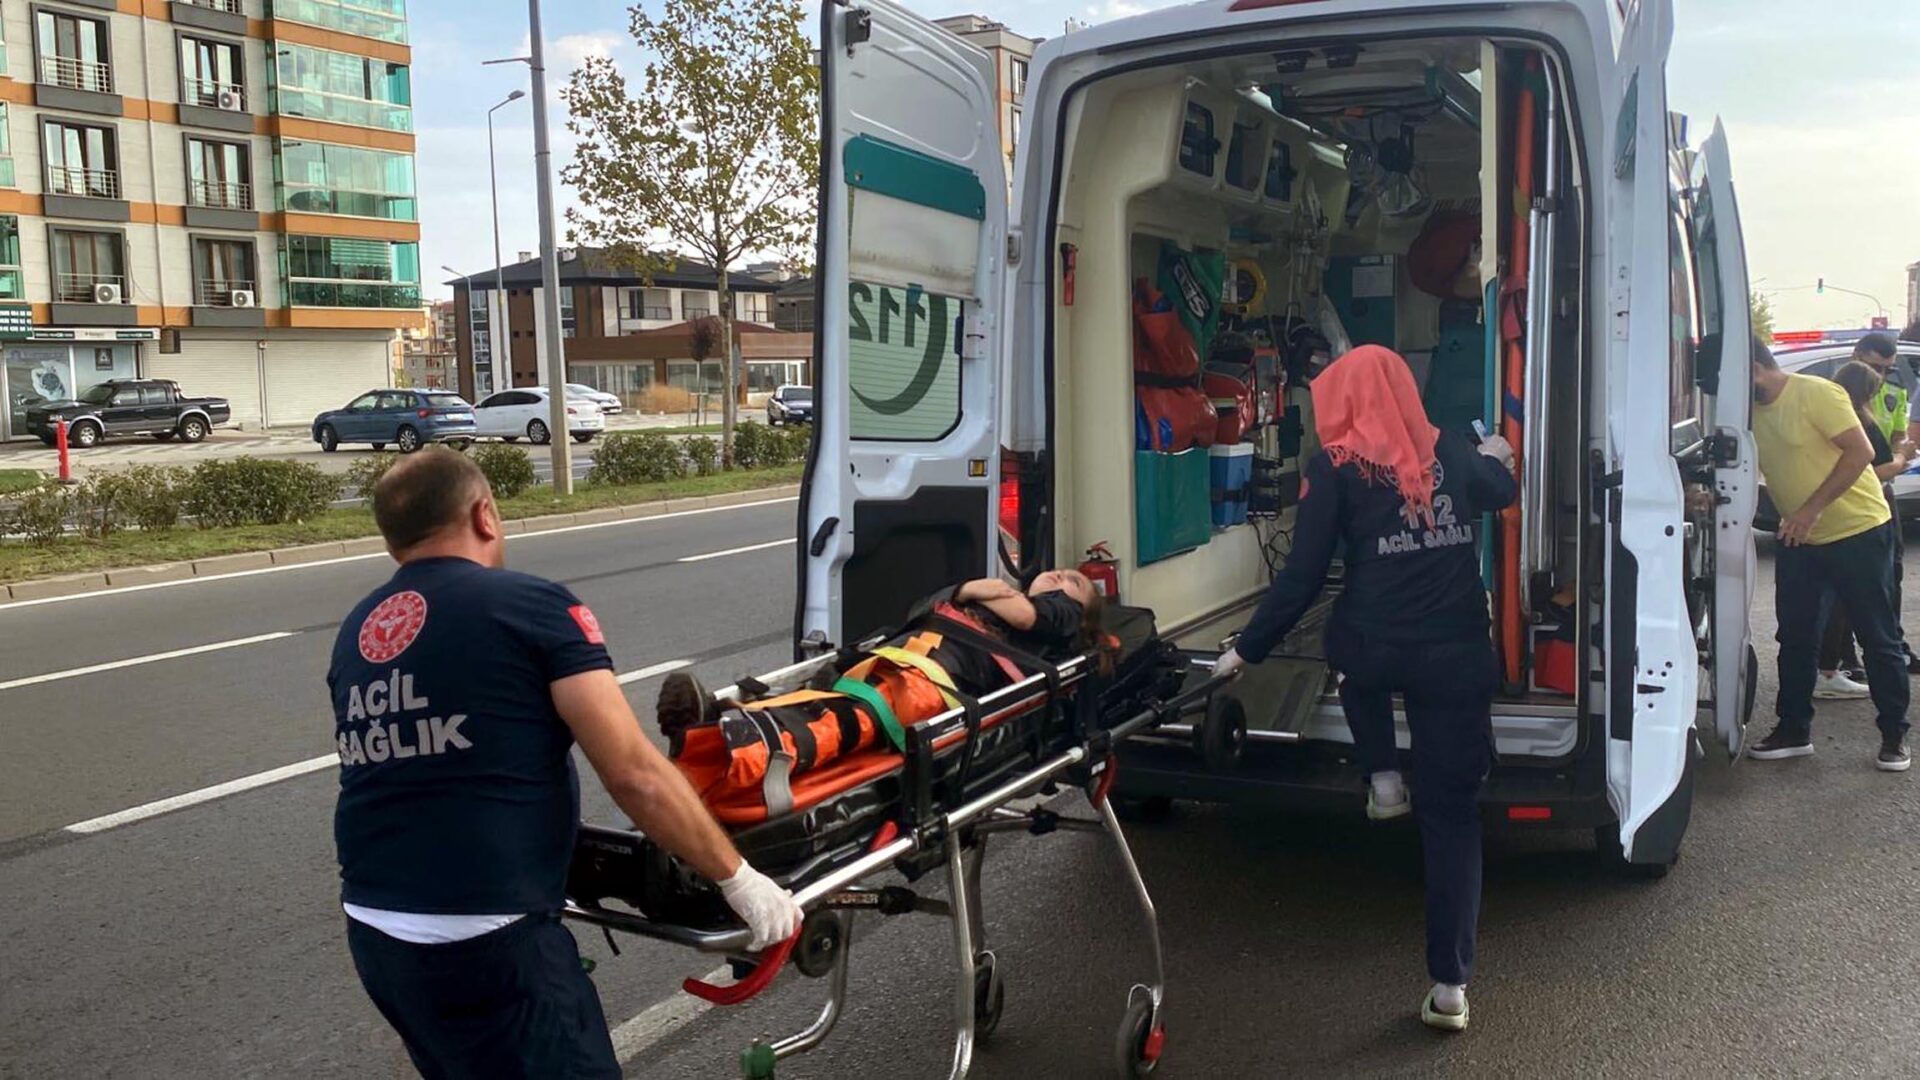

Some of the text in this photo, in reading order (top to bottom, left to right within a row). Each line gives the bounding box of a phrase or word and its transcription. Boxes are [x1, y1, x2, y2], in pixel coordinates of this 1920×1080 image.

[1378, 524, 1473, 555] ACİL SAĞLI
[346, 668, 428, 722] ACİL
[338, 714, 473, 766] SAĞLIK
